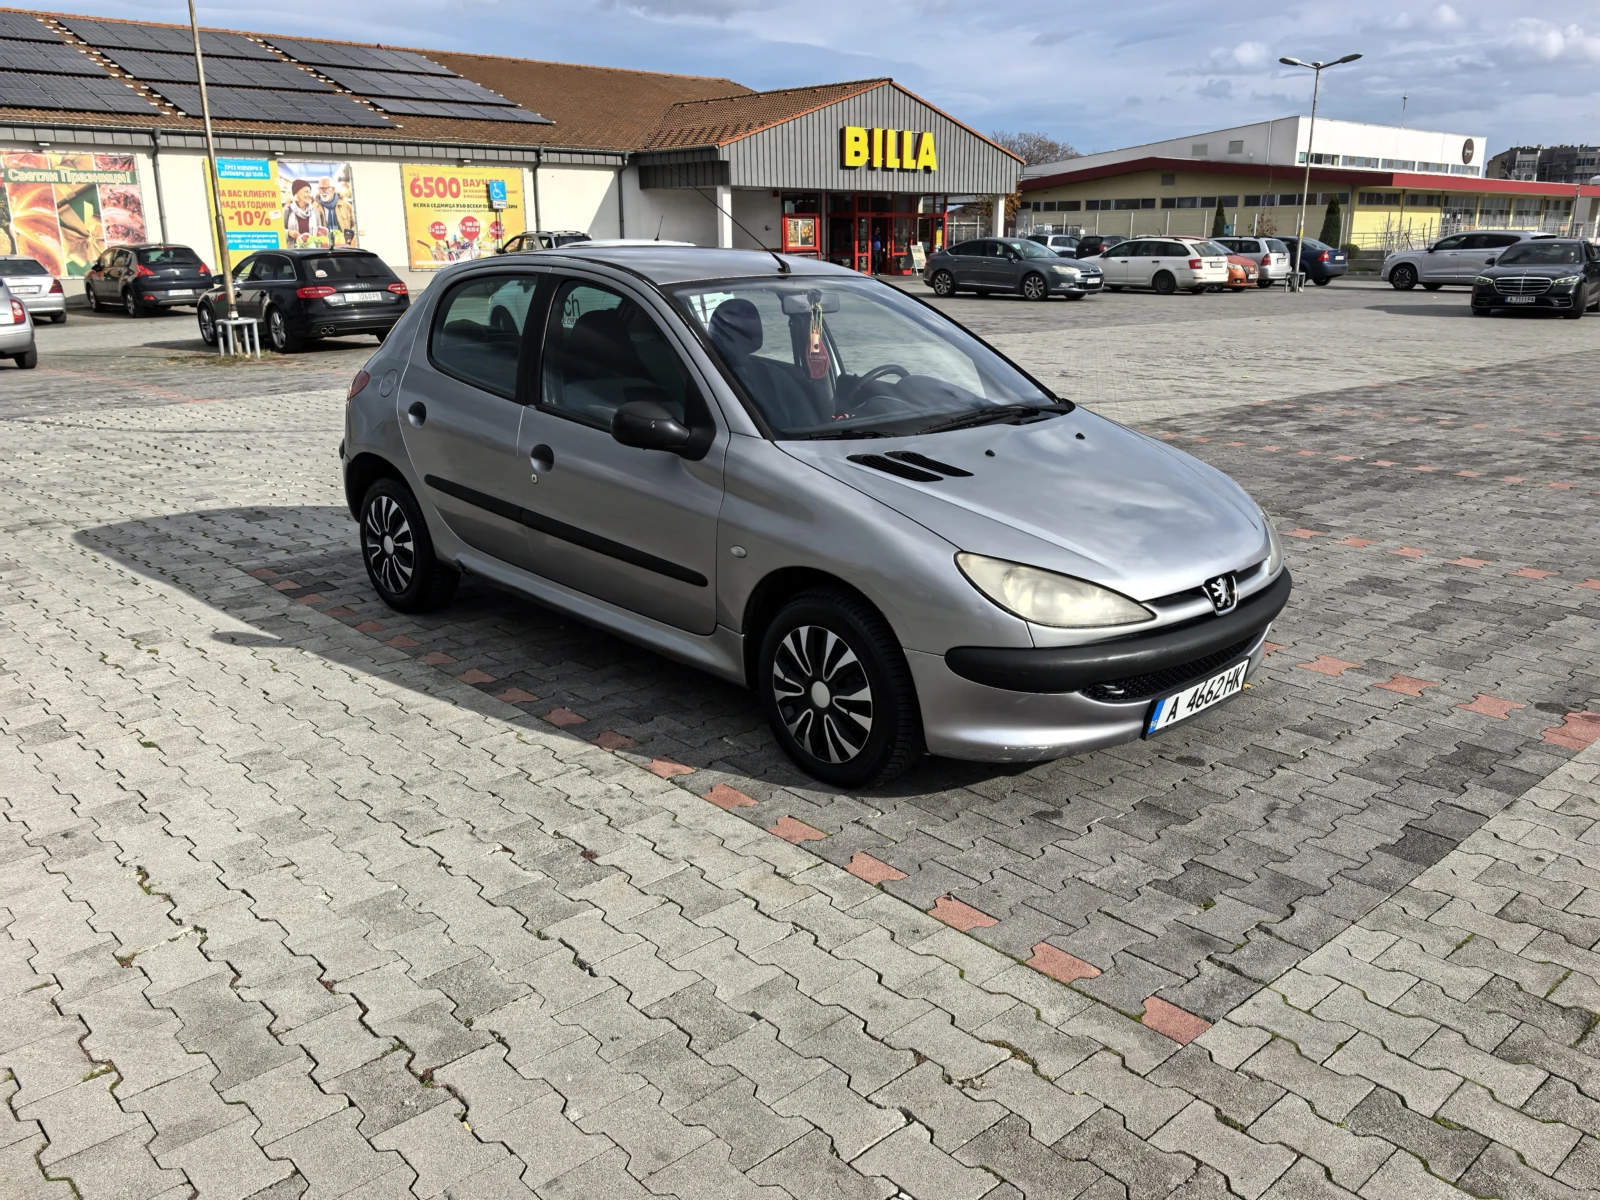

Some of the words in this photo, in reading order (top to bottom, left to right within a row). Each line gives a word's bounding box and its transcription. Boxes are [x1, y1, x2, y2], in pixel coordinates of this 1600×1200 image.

[843, 126, 937, 171] BILLA
[7, 168, 59, 183] Светли
[60, 169, 132, 185] Празници!
[227, 190, 242, 198] ВАС
[243, 190, 277, 198] КЛИЕНТИ
[410, 176, 461, 199] 6500
[237, 201, 246, 209] 65
[247, 201, 276, 209] ГОДИНИ
[228, 210, 271, 226] -10%
[1165, 696, 1180, 723] A
[1186, 663, 1245, 712] 4662HK
